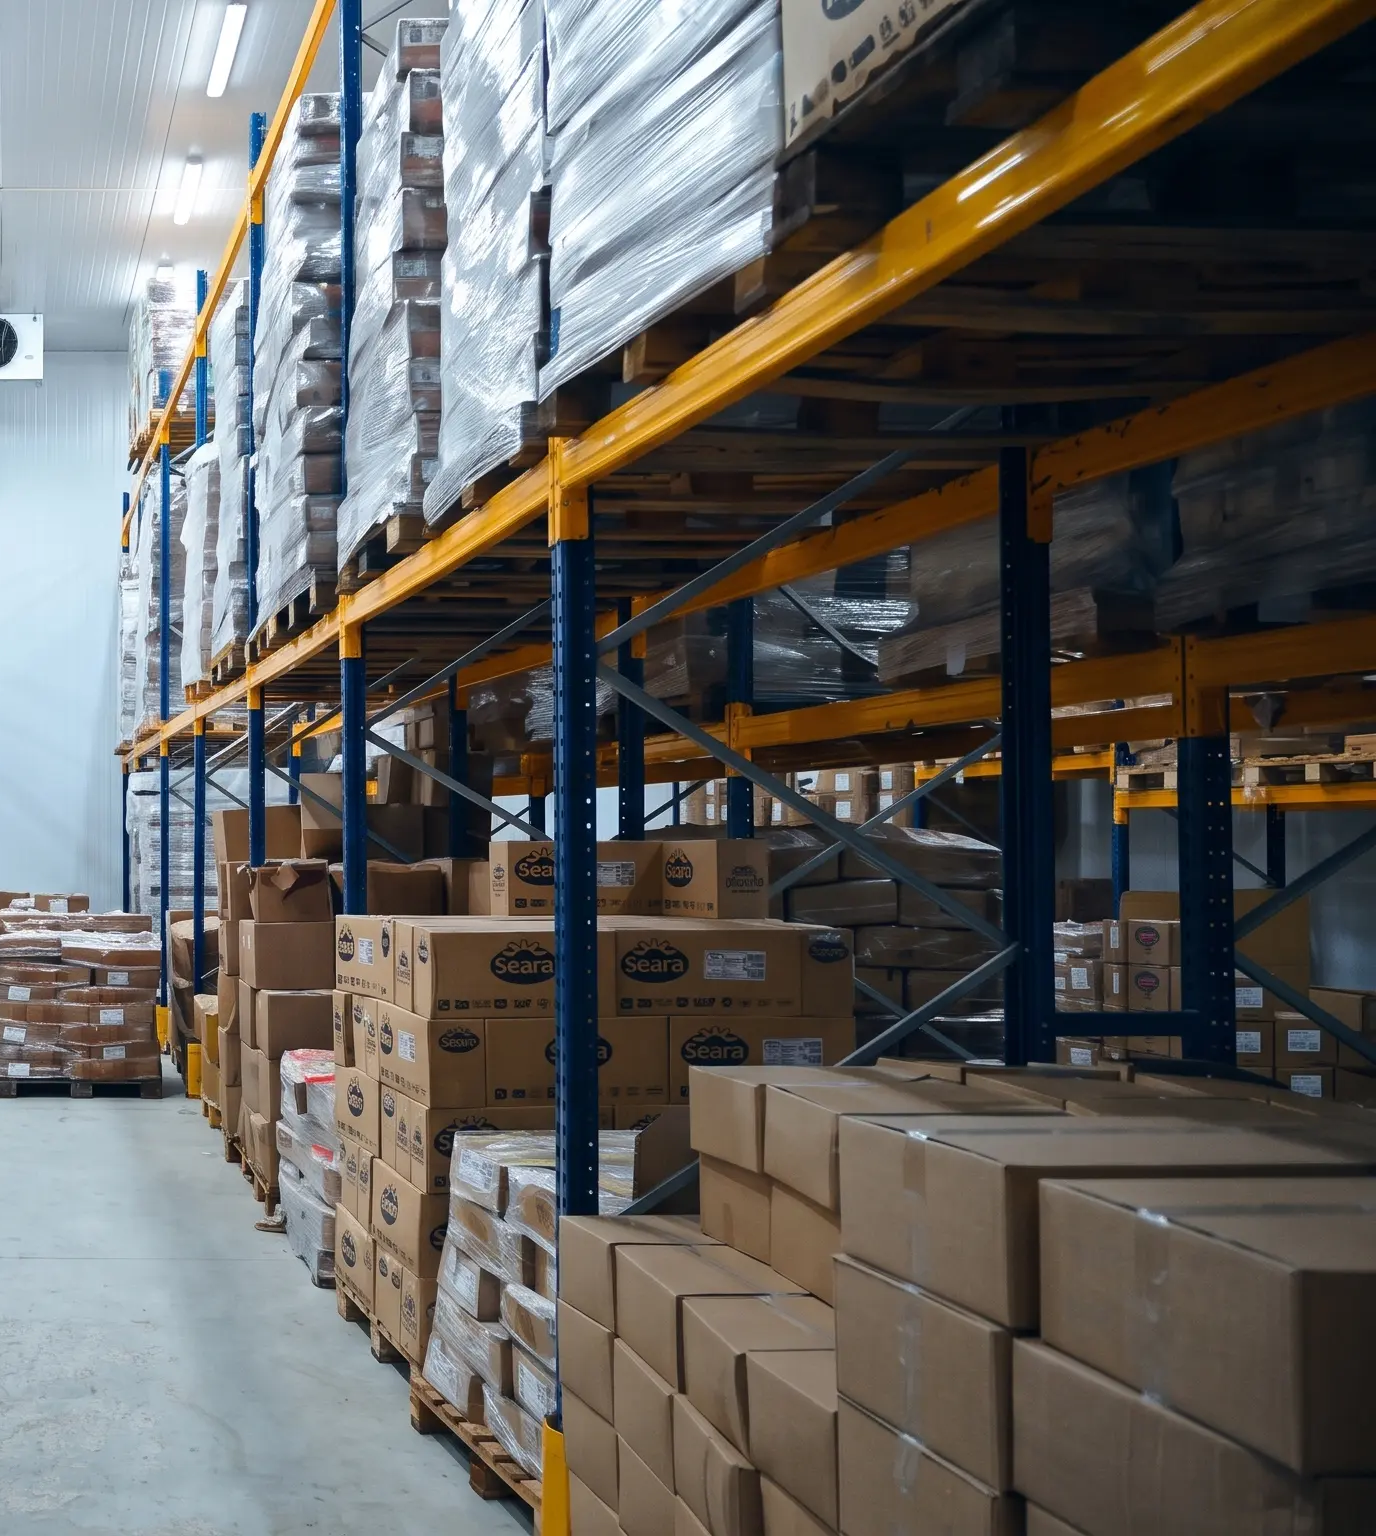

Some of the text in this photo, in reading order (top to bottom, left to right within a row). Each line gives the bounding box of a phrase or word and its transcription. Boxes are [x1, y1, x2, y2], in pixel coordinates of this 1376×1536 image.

[518, 862, 553, 877] Sea
[666, 864, 692, 879] Seara
[494, 957, 554, 974] Seara
[624, 955, 684, 973] Seara
[684, 1042, 744, 1059] Seara
